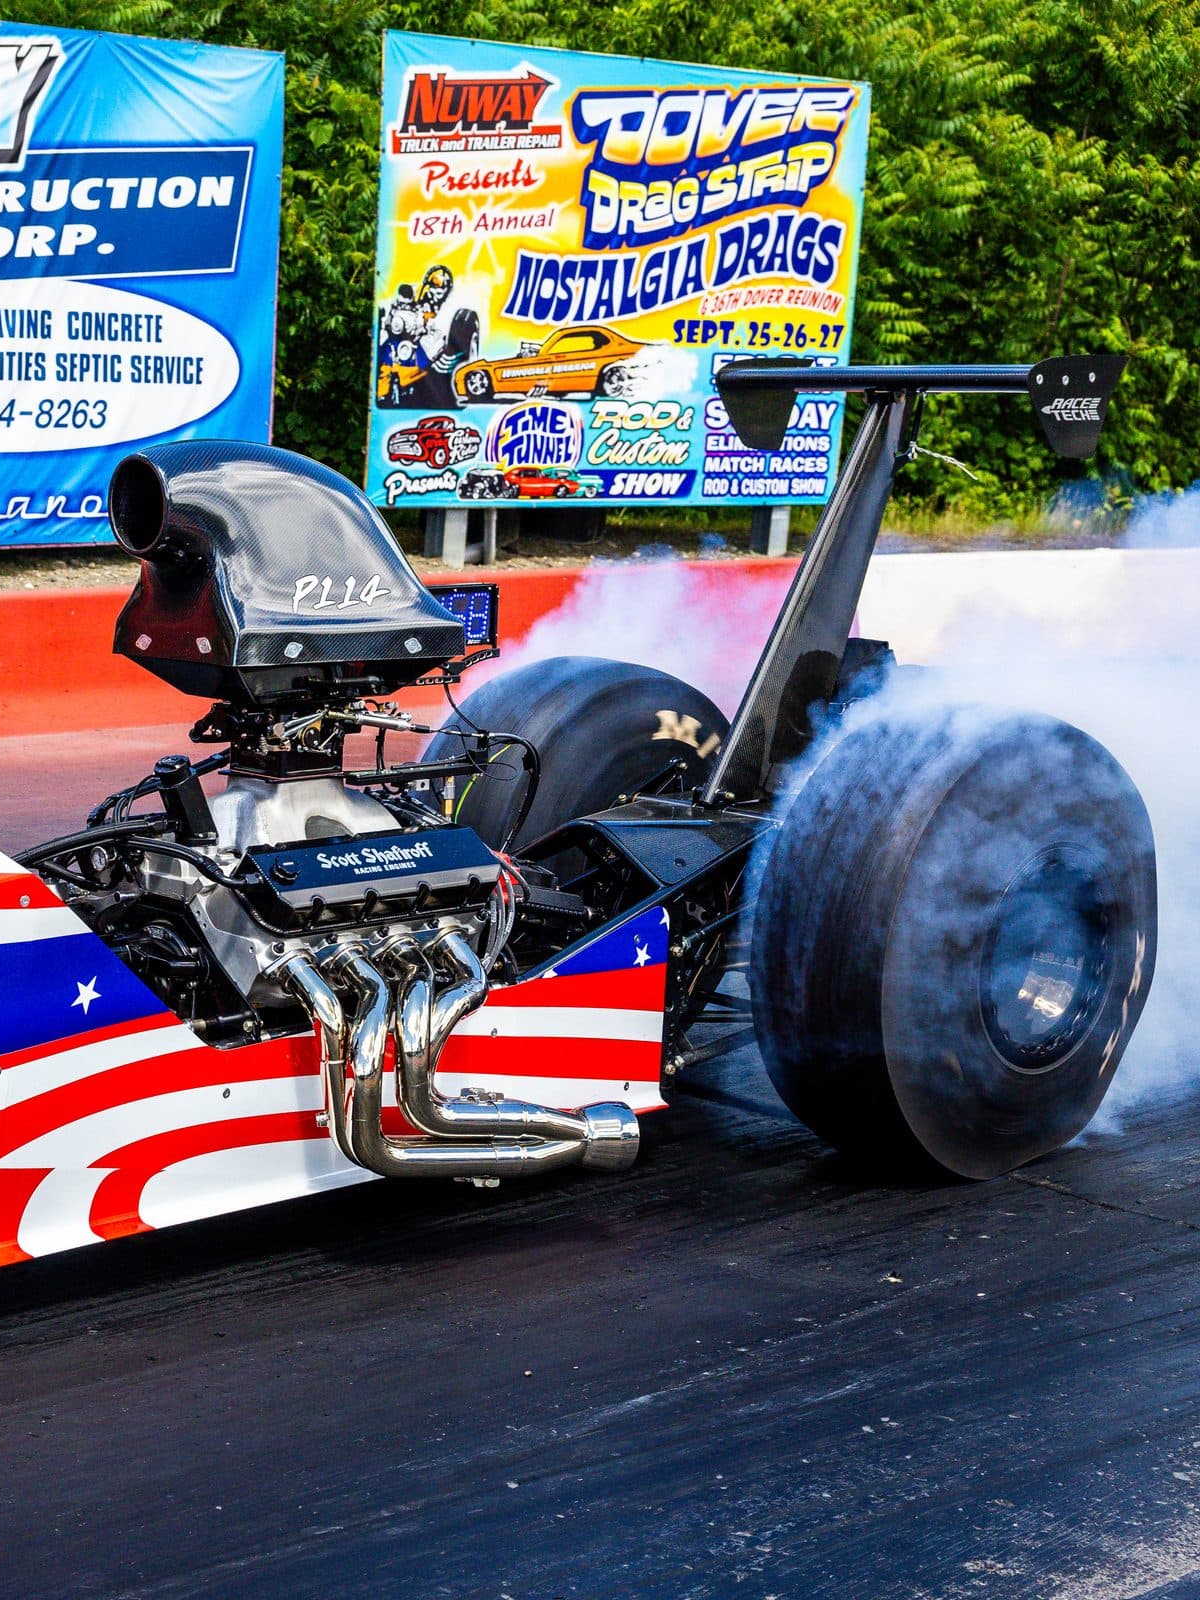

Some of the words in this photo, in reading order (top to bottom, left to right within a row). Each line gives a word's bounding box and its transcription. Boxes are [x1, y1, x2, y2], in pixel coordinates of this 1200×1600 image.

[401, 71, 552, 134] NUWAY
[573, 88, 856, 166] DOVER
[400, 138, 440, 153] TRUCK
[440, 137, 466, 152] and
[467, 136, 515, 150] TRAILER
[516, 134, 560, 149] REPAIR
[420, 158, 540, 193] Presents
[412, 214, 464, 238] 18th
[473, 208, 555, 232] Annual
[504, 239, 706, 322] NOSTALGIA
[712, 214, 843, 288] DRAGS
[711, 292, 741, 313] 36TH
[743, 288, 785, 307] DOVER
[787, 289, 843, 313] REUNION
[67, 311, 163, 343] CONCRETE
[672, 319, 741, 346] SEPT.
[747, 321, 845, 348] 25-26-27
[55, 353, 122, 383] SEPTIC
[130, 356, 204, 385] SERVICE
[591, 401, 681, 430] ROD
[1050, 398, 1093, 410] RACE
[1050, 409, 1092, 421] TECH
[506, 406, 569, 436] TIME
[501, 433, 573, 467] TUNNEL
[587, 429, 690, 465] Custom
[704, 457, 766, 473] MATCH
[768, 457, 828, 473] RACES
[385, 472, 458, 505] Presents
[608, 472, 687, 496] SHOW
[703, 478, 730, 495] ROD
[730, 478, 740, 495] &
[741, 478, 789, 495] CUSTOM
[790, 478, 827, 495] SHOW
[316, 852, 362, 870] Scott
[360, 841, 434, 866] Shafiroff
[353, 865, 383, 876] RACING
[383, 861, 417, 872] ENGINES
